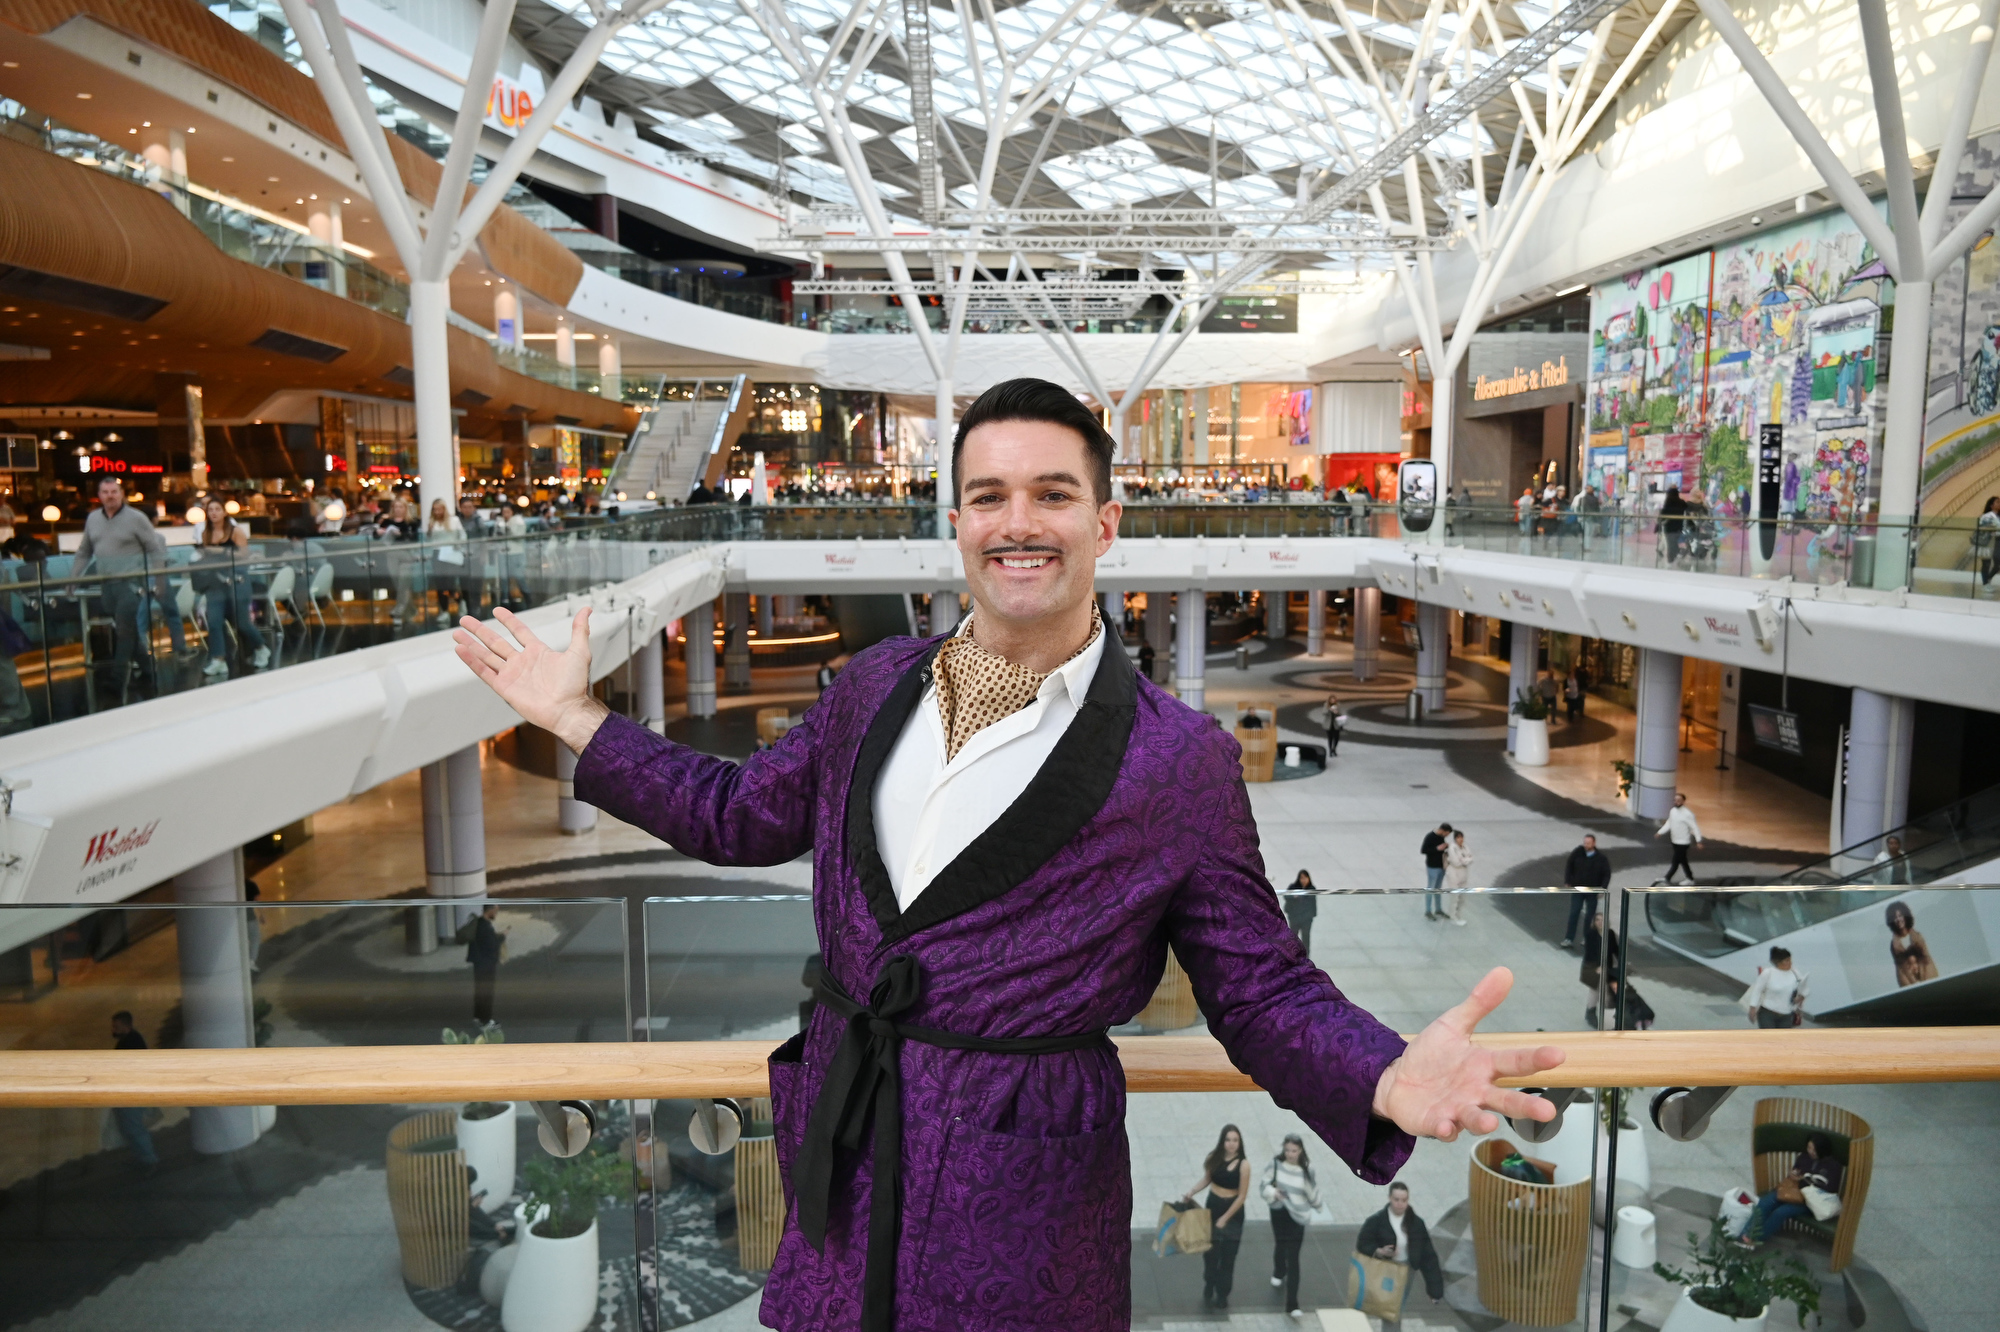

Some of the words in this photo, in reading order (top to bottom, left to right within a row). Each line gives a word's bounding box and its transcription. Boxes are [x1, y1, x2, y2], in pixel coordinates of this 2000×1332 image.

[1529, 369, 1540, 390] &
[92, 456, 127, 472] Pho
[81, 817, 161, 871] Westfield
